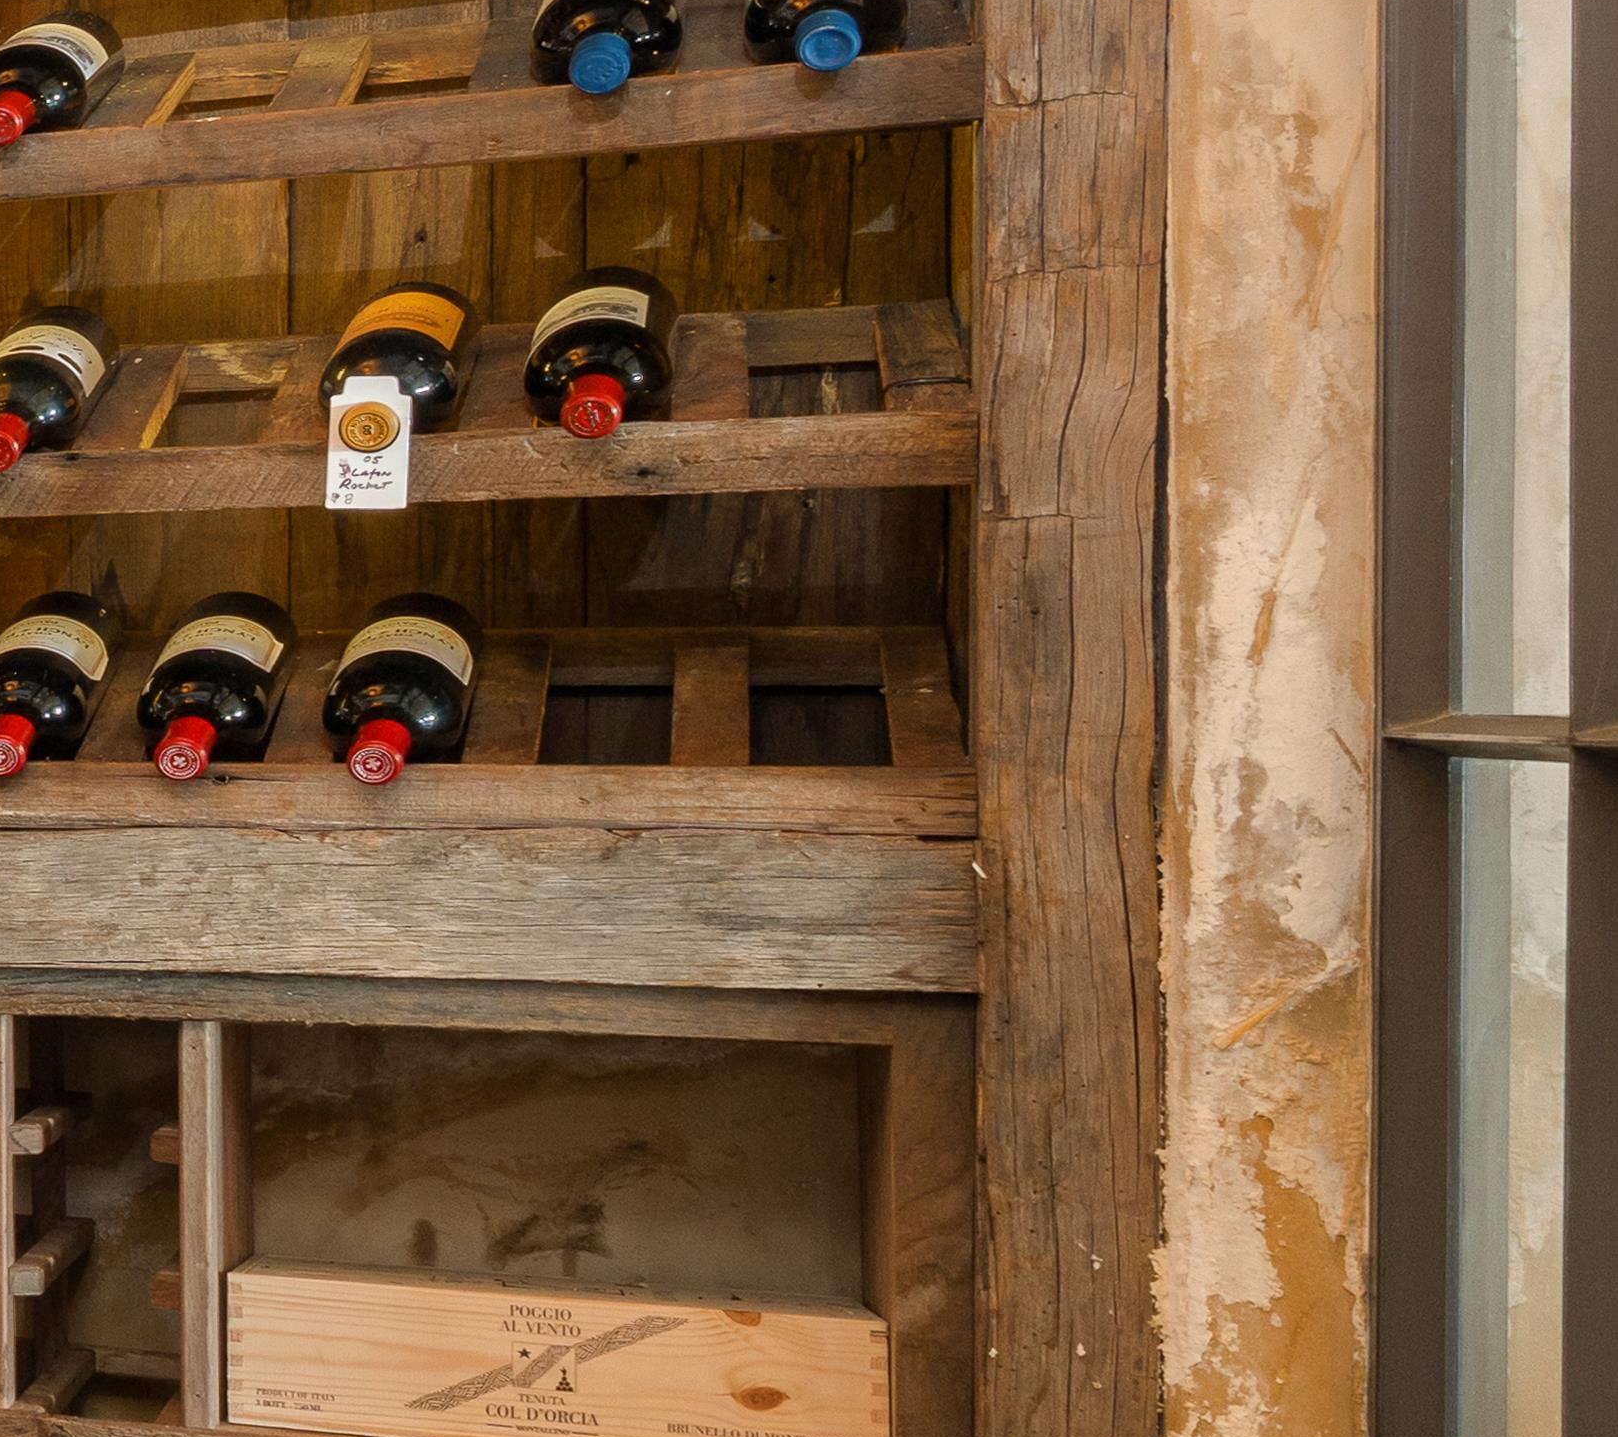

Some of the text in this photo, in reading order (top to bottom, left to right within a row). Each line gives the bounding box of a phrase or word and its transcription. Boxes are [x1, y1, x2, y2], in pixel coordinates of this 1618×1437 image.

[36, 625, 90, 650] LYNCH
[198, 627, 257, 643] LYNCH
[509, 1304, 573, 1322] POGGIO
[499, 1320, 582, 1339] AL VENTO
[518, 1393, 567, 1407] TENUTA
[485, 1403, 599, 1427] COL D'ORCIA
[515, 1424, 572, 1435] MONTALCINO
